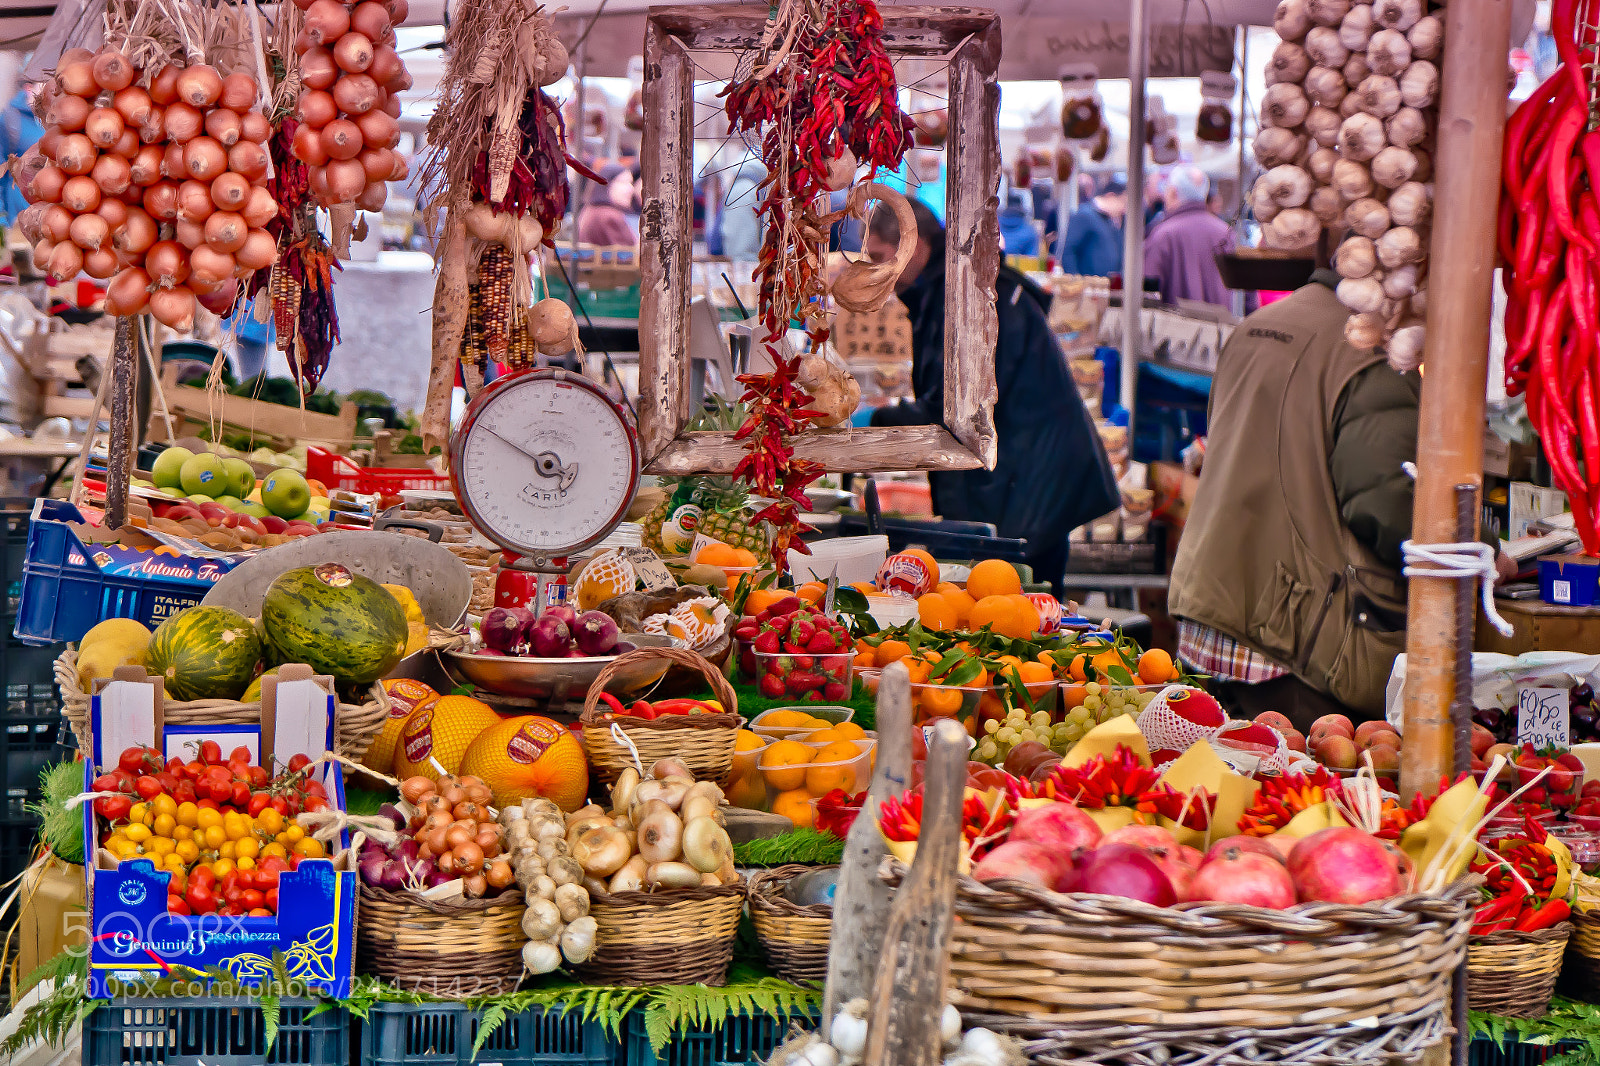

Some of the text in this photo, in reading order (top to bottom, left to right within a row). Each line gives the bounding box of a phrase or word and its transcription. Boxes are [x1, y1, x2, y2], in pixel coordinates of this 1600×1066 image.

[522, 485, 568, 501] LARIO
[141, 556, 195, 580] Antonio
[152, 603, 167, 616] DI
